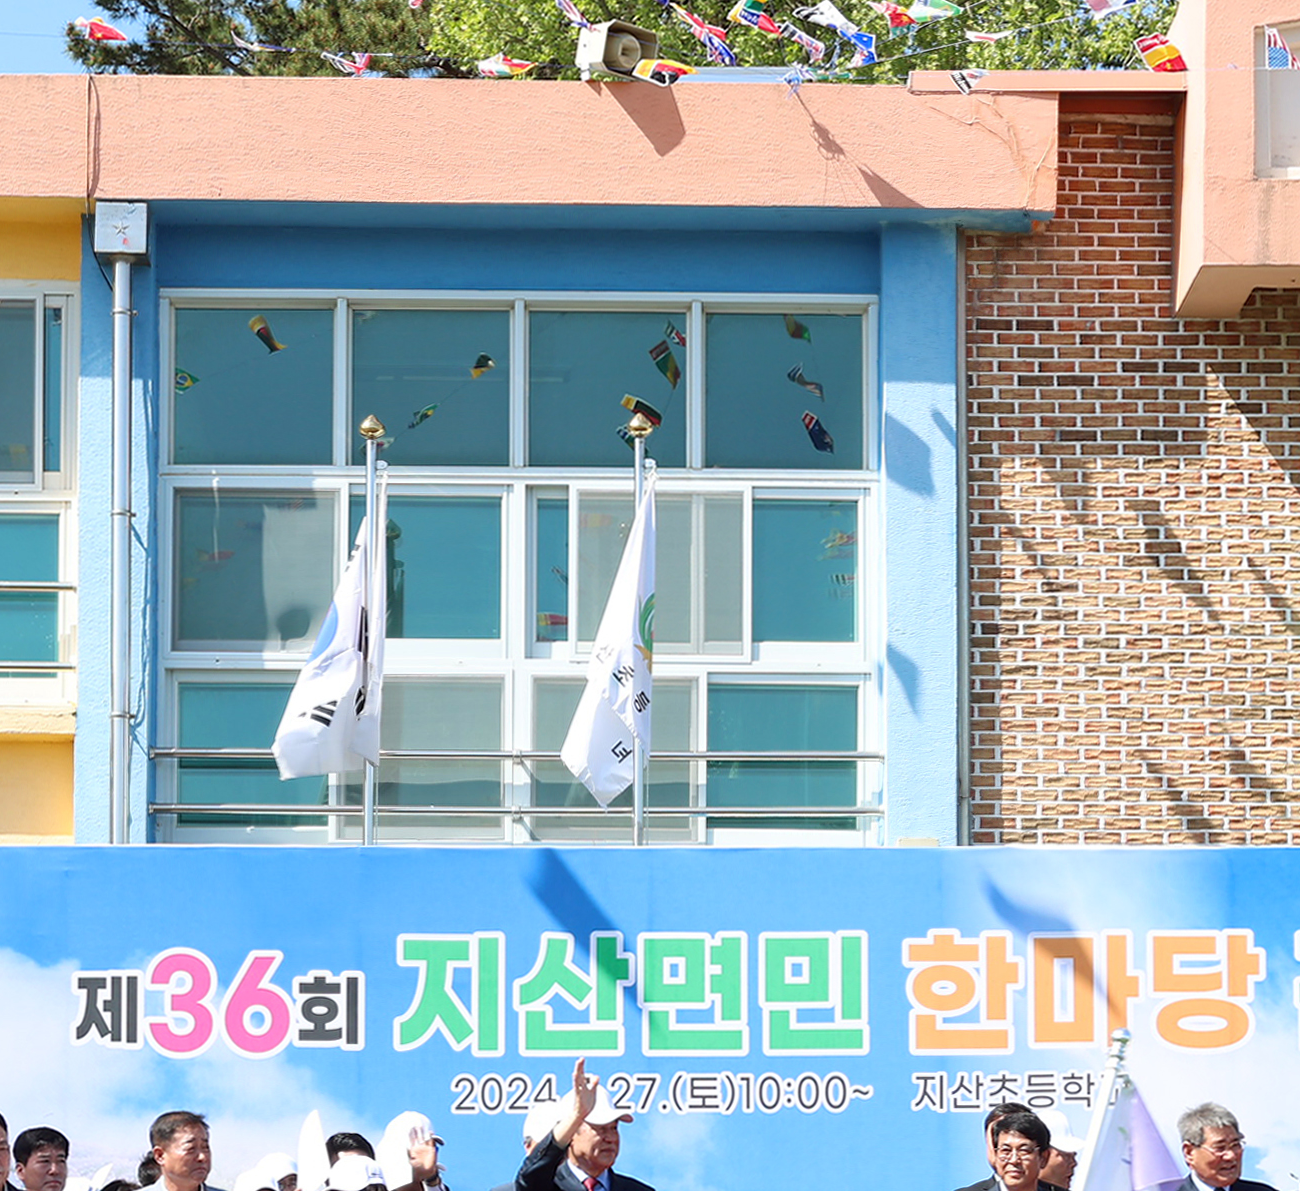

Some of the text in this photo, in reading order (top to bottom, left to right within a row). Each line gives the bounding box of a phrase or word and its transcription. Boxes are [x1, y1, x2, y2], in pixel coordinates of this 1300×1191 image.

[73, 948, 364, 1058] 제36회
[393, 931, 870, 1057] 지산면민
[903, 929, 1265, 1057] 한마당
